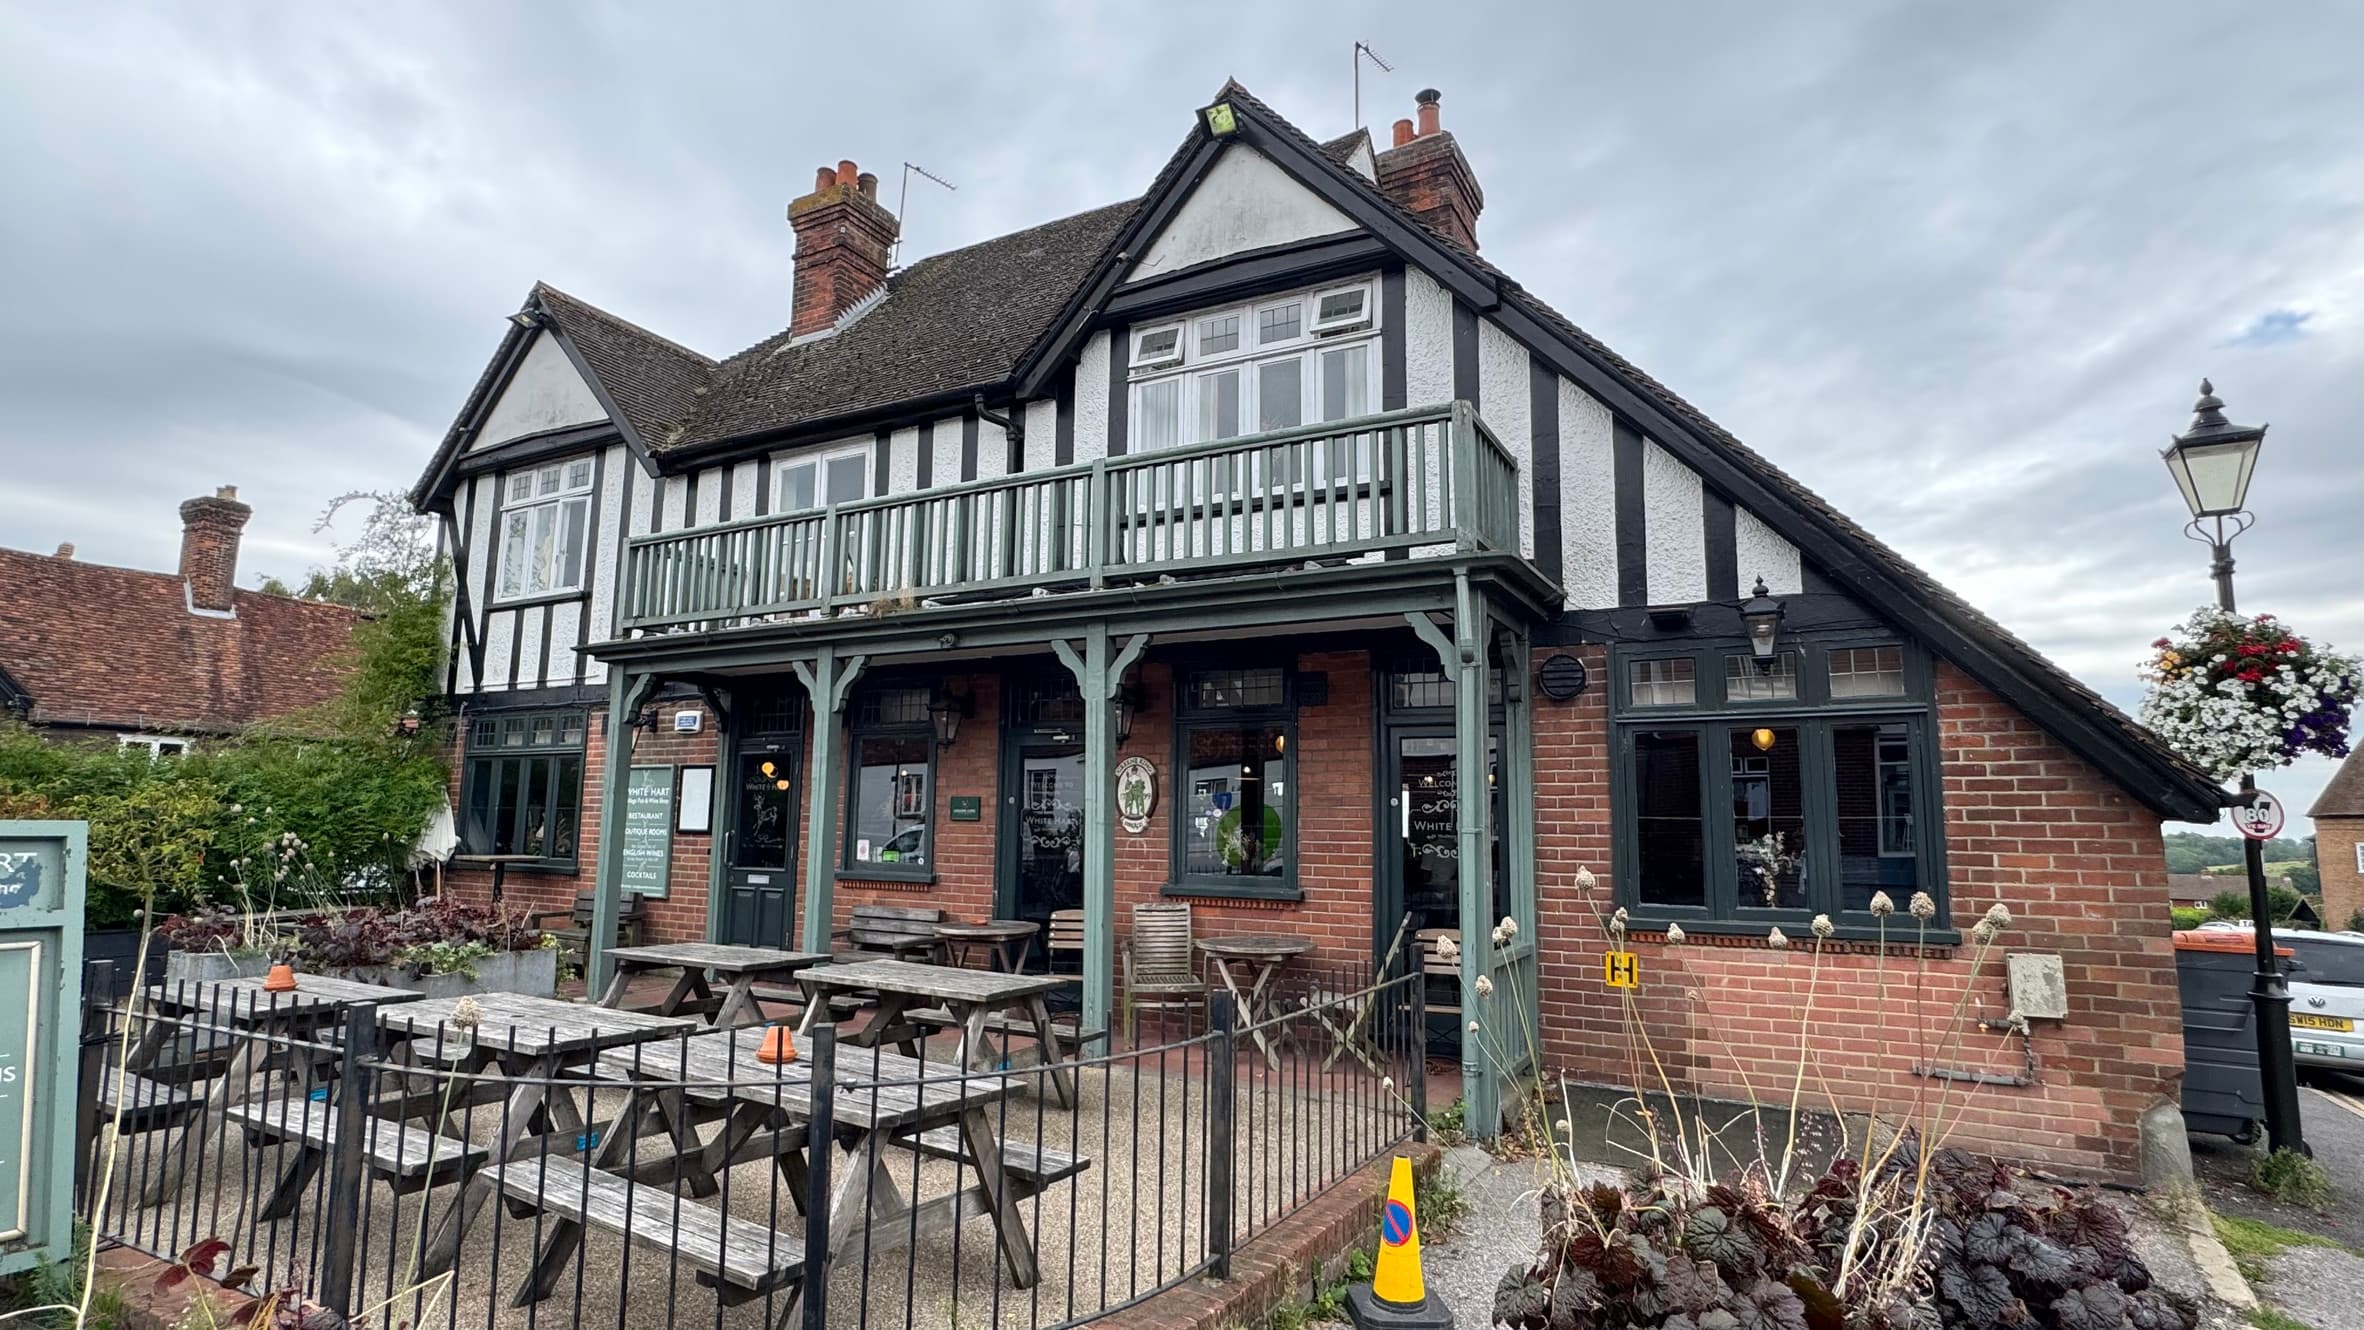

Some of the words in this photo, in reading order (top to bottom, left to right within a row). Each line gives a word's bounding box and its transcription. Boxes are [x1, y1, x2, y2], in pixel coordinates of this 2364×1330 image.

[650, 787, 670, 796] HART
[628, 812, 663, 820] RESTAURANT
[2245, 808, 2270, 822] 80
[1414, 821, 1452, 831] WHITE
[625, 828, 648, 836] OUTIQUE
[626, 870, 657, 880] COCKTAILS
[1610, 955, 1634, 984] H
